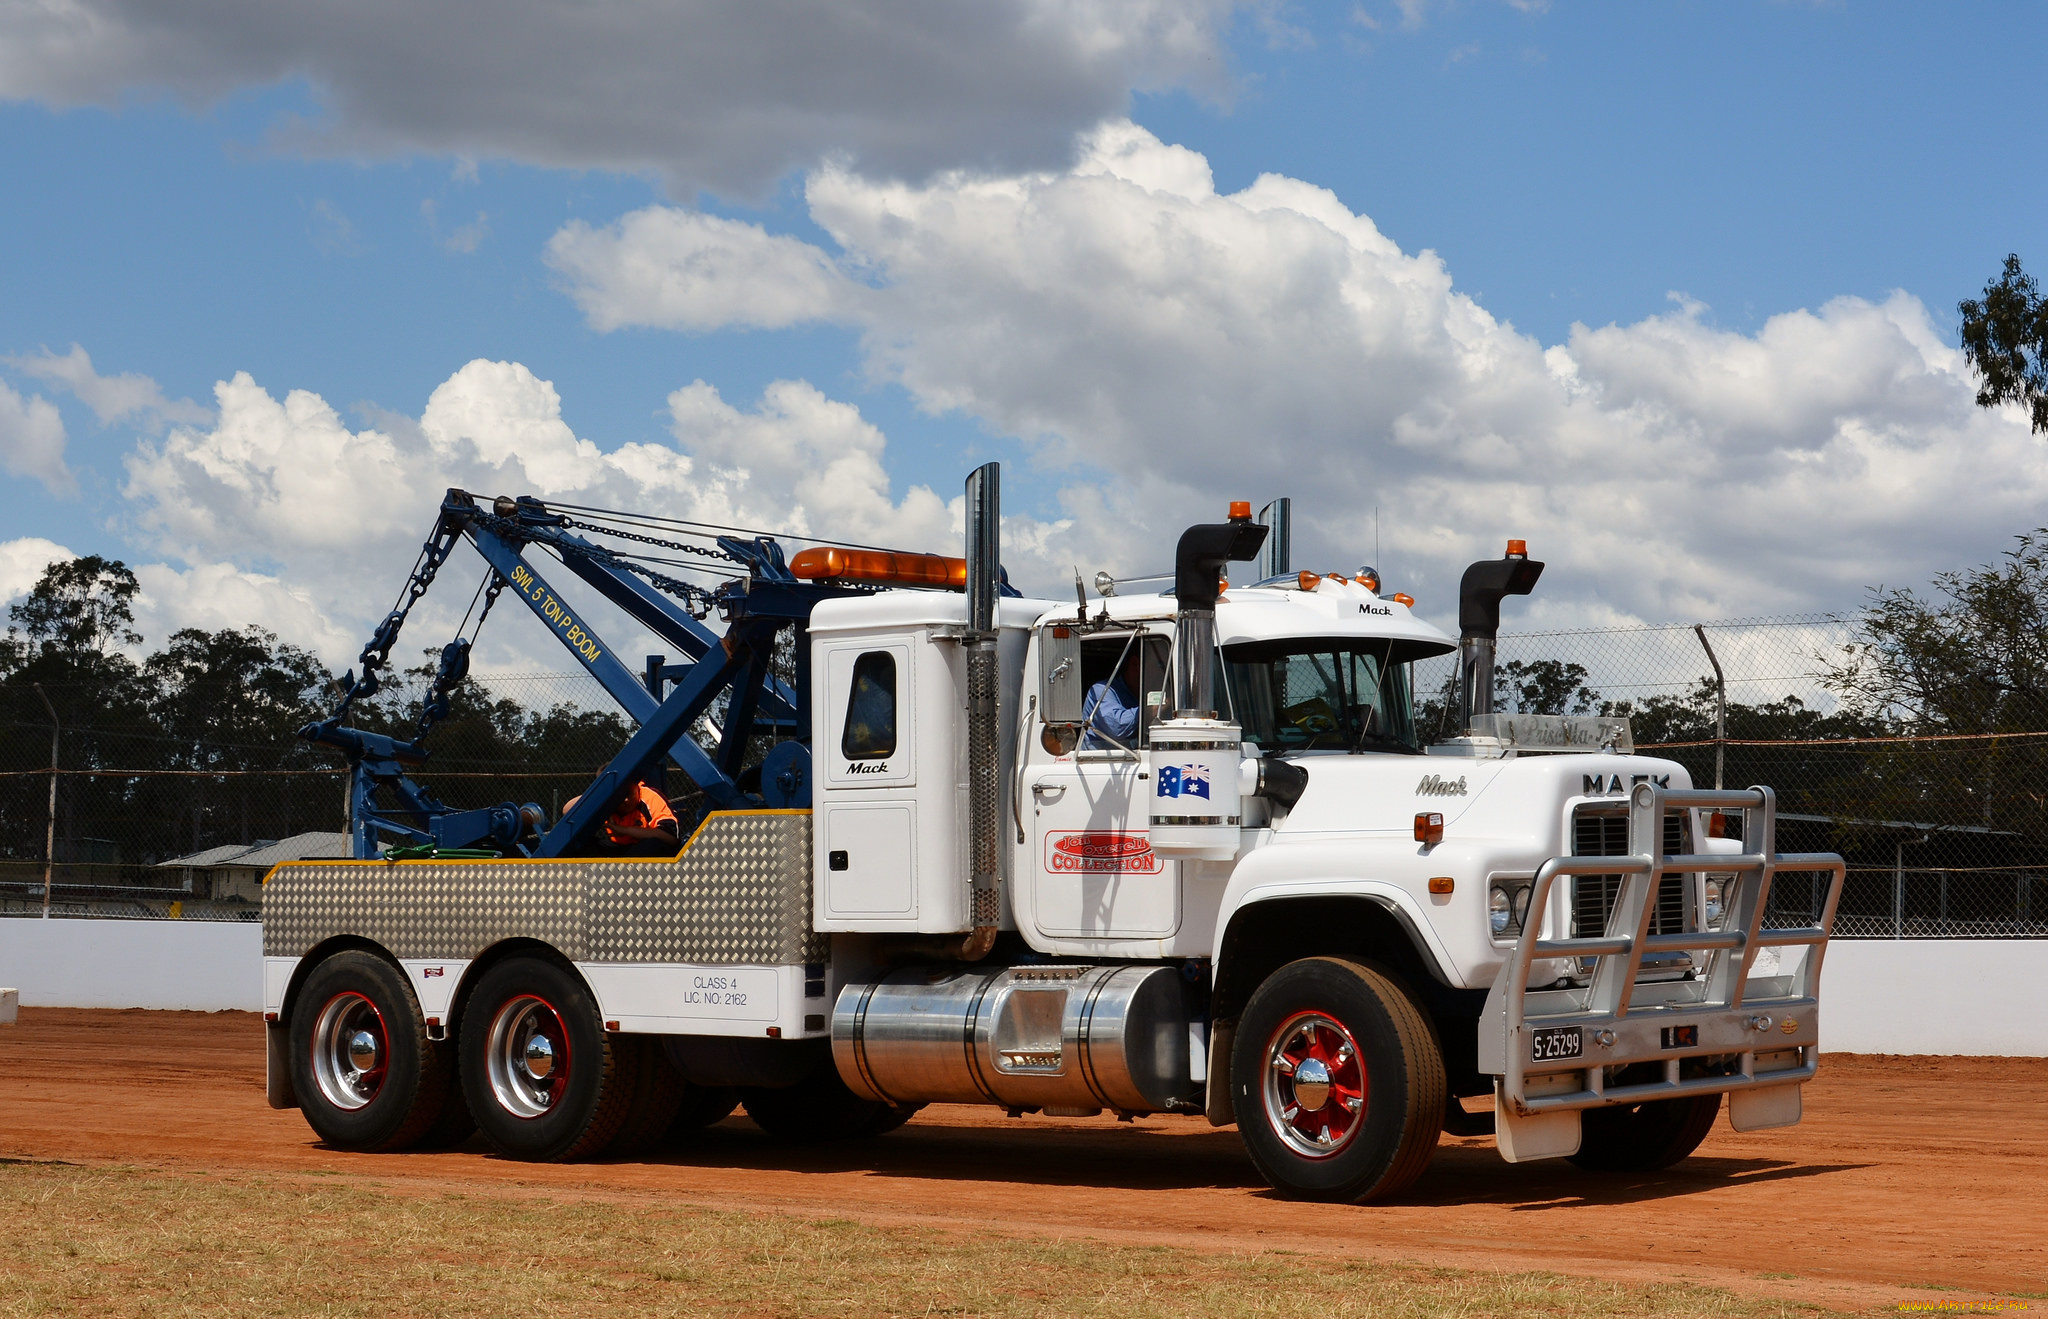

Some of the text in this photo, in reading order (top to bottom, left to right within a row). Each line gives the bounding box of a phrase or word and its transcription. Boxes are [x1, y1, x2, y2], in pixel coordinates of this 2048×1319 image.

[511, 565, 534, 594] SWL
[531, 586, 545, 601] 5
[540, 595, 564, 623] TON
[566, 624, 602, 663] BOOM
[1358, 603, 1393, 617] Mack
[1520, 717, 1589, 746] Prisclla
[845, 761, 889, 775] Mack
[1415, 774, 1468, 797] Mack
[1062, 835, 1091, 850] Jon
[1081, 837, 1147, 856] Overell
[1052, 852, 1156, 872] COLLECTION
[693, 976, 737, 990] CLASS 4
[684, 991, 747, 1006] LIC. NO: 2162
